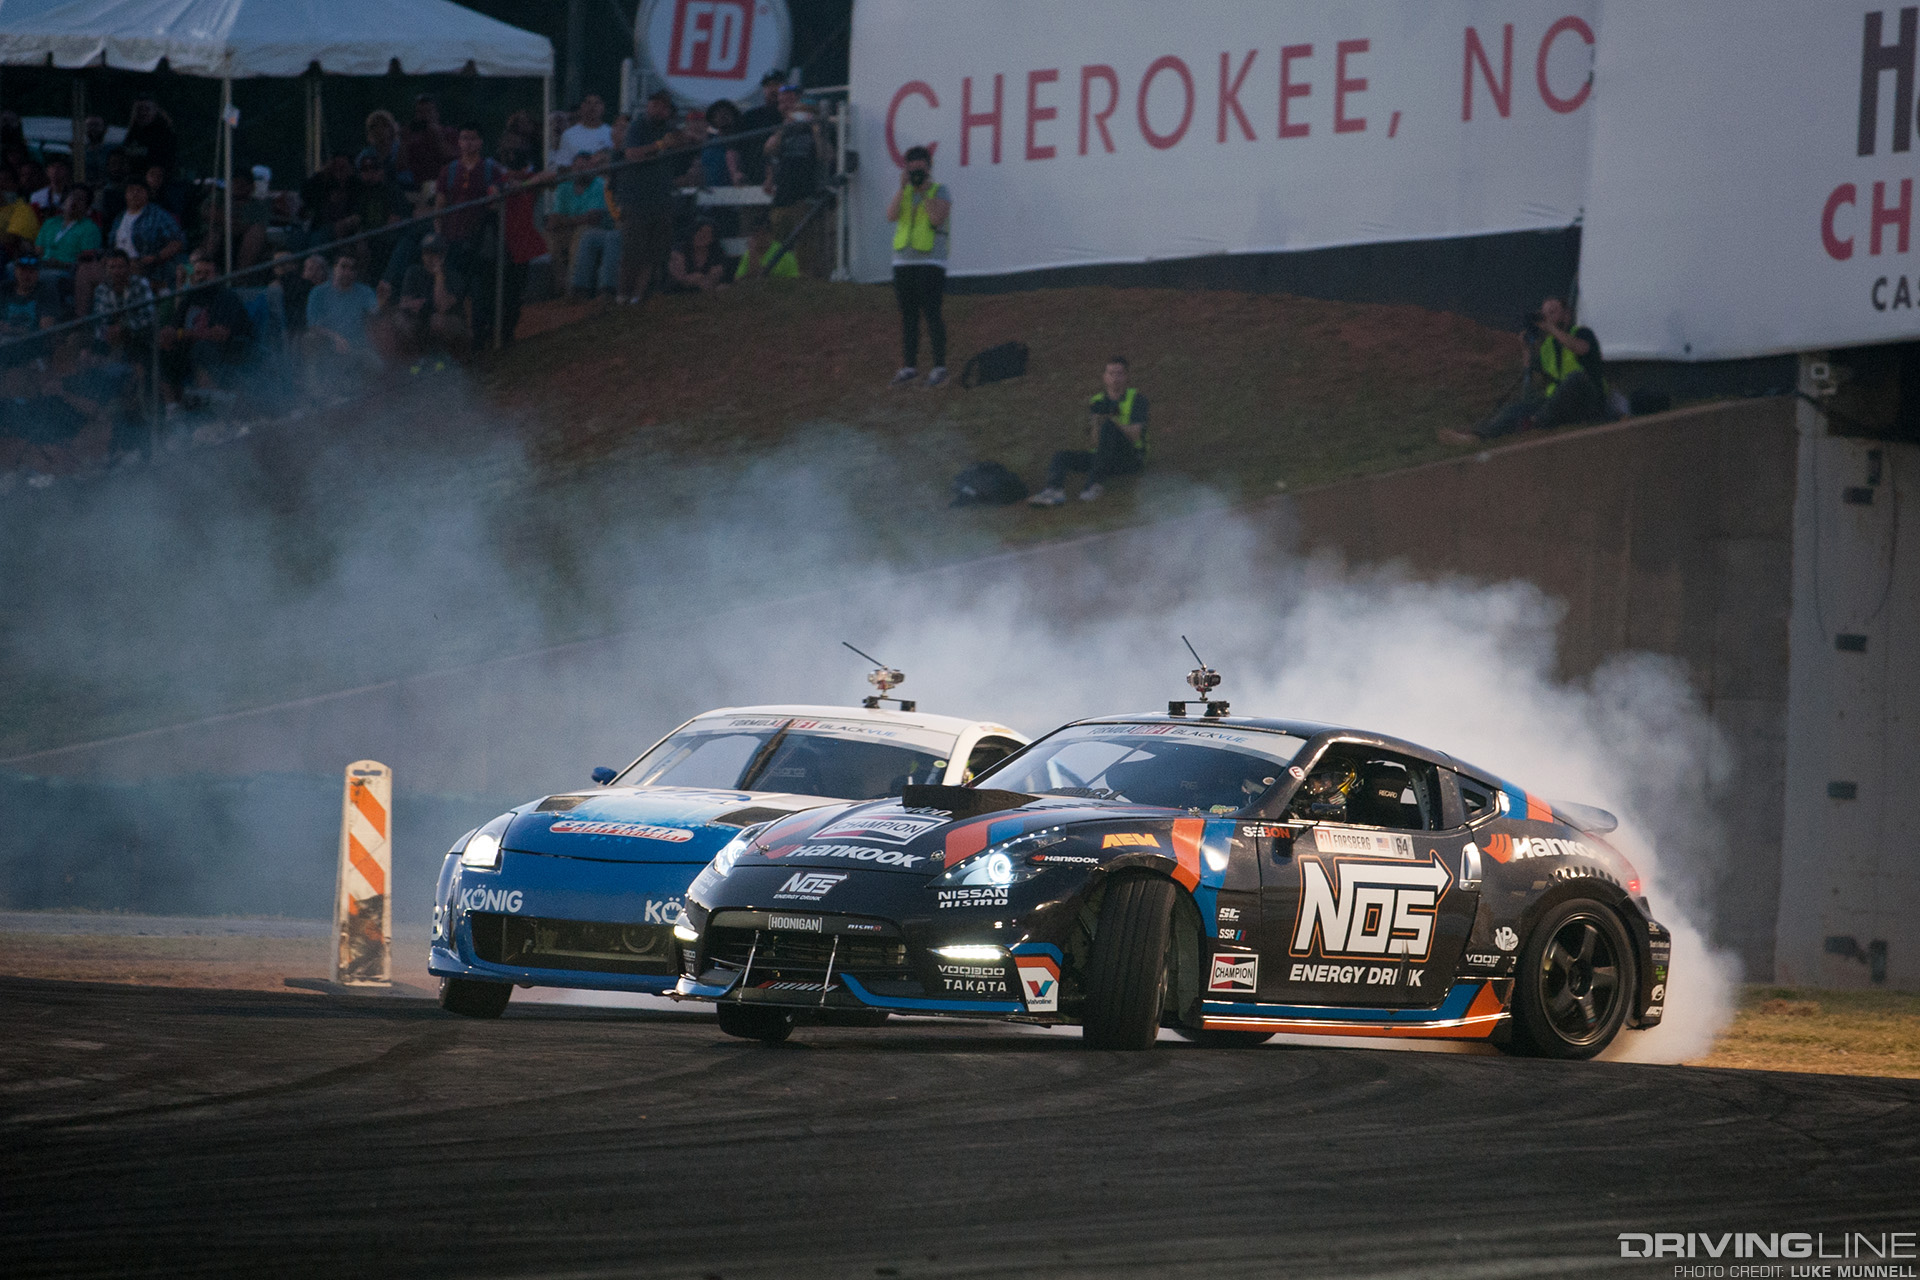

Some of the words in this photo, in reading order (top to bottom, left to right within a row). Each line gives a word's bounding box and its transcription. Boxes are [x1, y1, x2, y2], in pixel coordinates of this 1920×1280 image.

[678, 1, 747, 73] FD
[1857, 6, 1920, 157] H
[884, 38, 1401, 169] CHEROKEE,
[1461, 15, 1595, 122] NC
[1871, 274, 1920, 312] CA
[1171, 727, 1248, 743] BLACKVUE
[835, 819, 922, 834] CHAMPION
[1242, 826, 1291, 839] SEIBON
[1102, 833, 1160, 849] AEM
[1333, 834, 1371, 850] FORSBERG
[1396, 838, 1409, 855] 64
[779, 873, 848, 894] NOS
[459, 884, 523, 913] KÖNIG
[773, 893, 800, 901] ENERGY
[799, 894, 823, 902] DRINK
[938, 888, 1008, 900] NISSAN
[1294, 858, 1449, 955] NOS
[1218, 928, 1236, 940] SSR
[1214, 967, 1253, 979] CHAMPION
[1289, 963, 1366, 984] ENERGY
[1366, 967, 1425, 987] DRIK
[943, 978, 1007, 992] TAKATA
